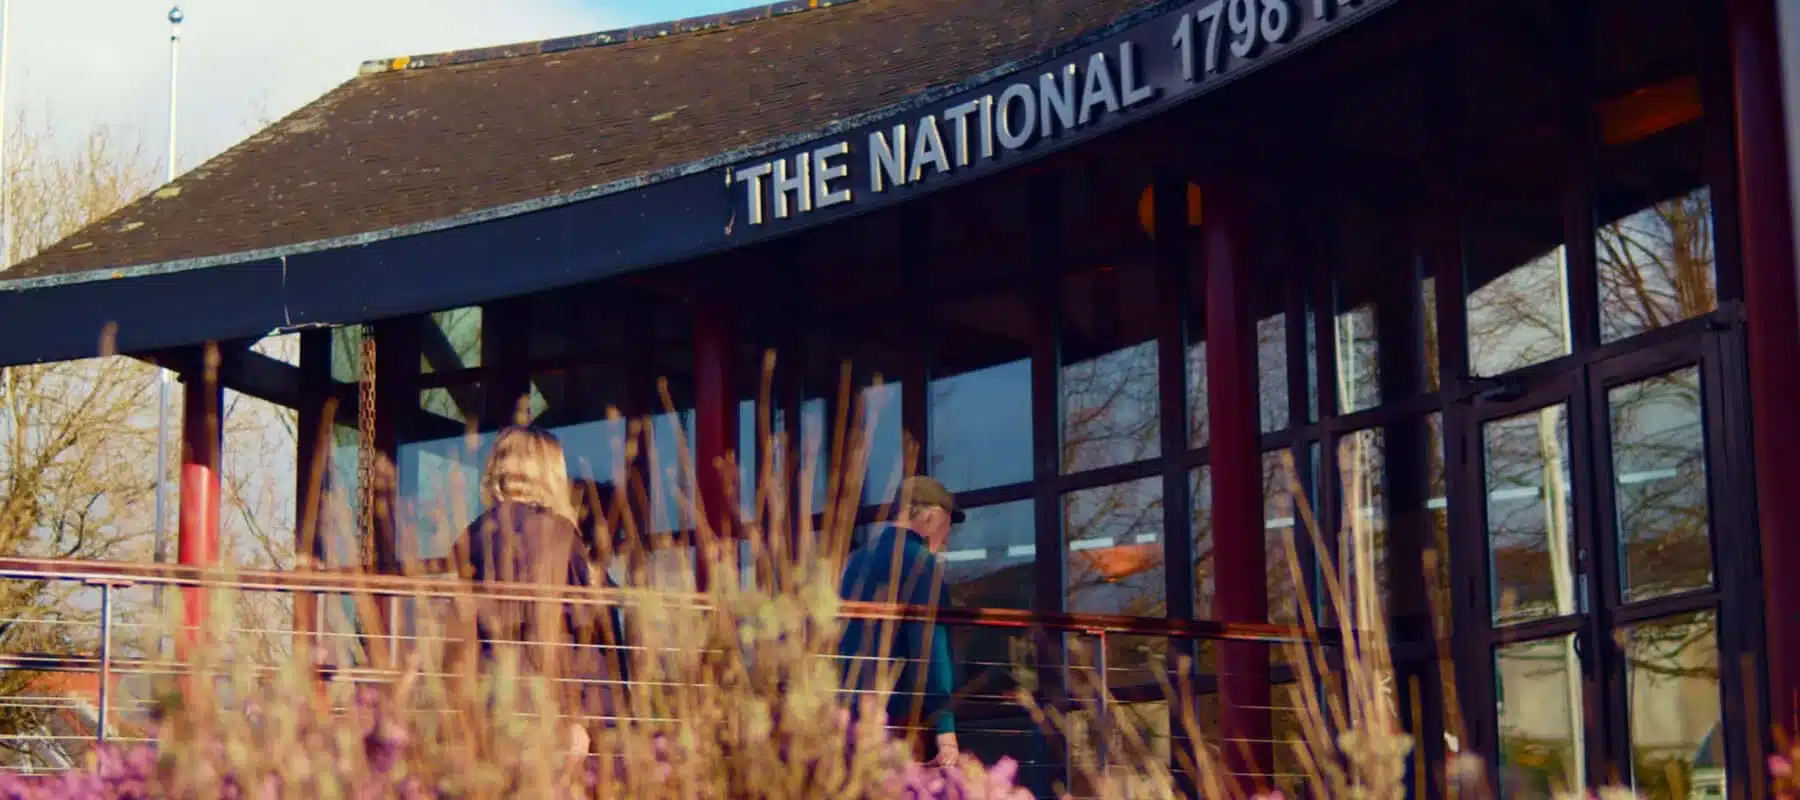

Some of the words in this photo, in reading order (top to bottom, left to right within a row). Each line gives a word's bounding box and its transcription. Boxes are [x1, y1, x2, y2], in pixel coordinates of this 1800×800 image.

[736, 141, 851, 225] THE
[868, 41, 1151, 193] NATIONAL
[1172, 0, 1288, 82] 1798
